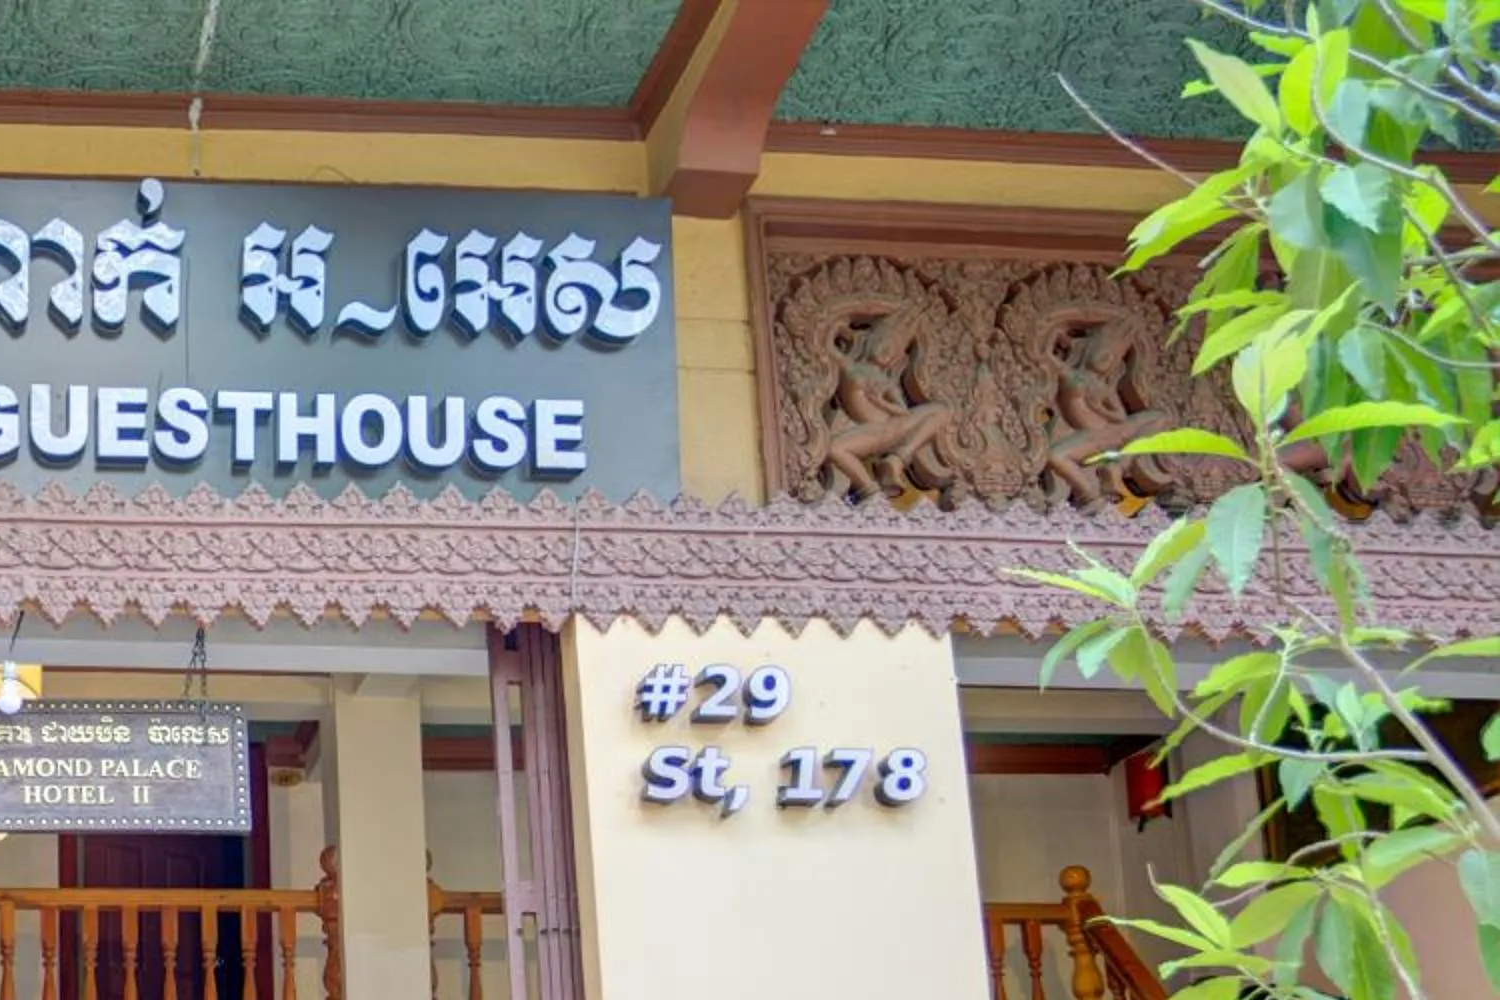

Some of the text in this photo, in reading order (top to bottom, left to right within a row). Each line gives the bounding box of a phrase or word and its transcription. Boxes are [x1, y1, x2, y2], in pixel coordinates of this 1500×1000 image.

[636, 663, 792, 724] #29
[100, 758, 202, 780] PALACE
[776, 746, 929, 808] 178
[22, 784, 153, 805] HOTEL II
